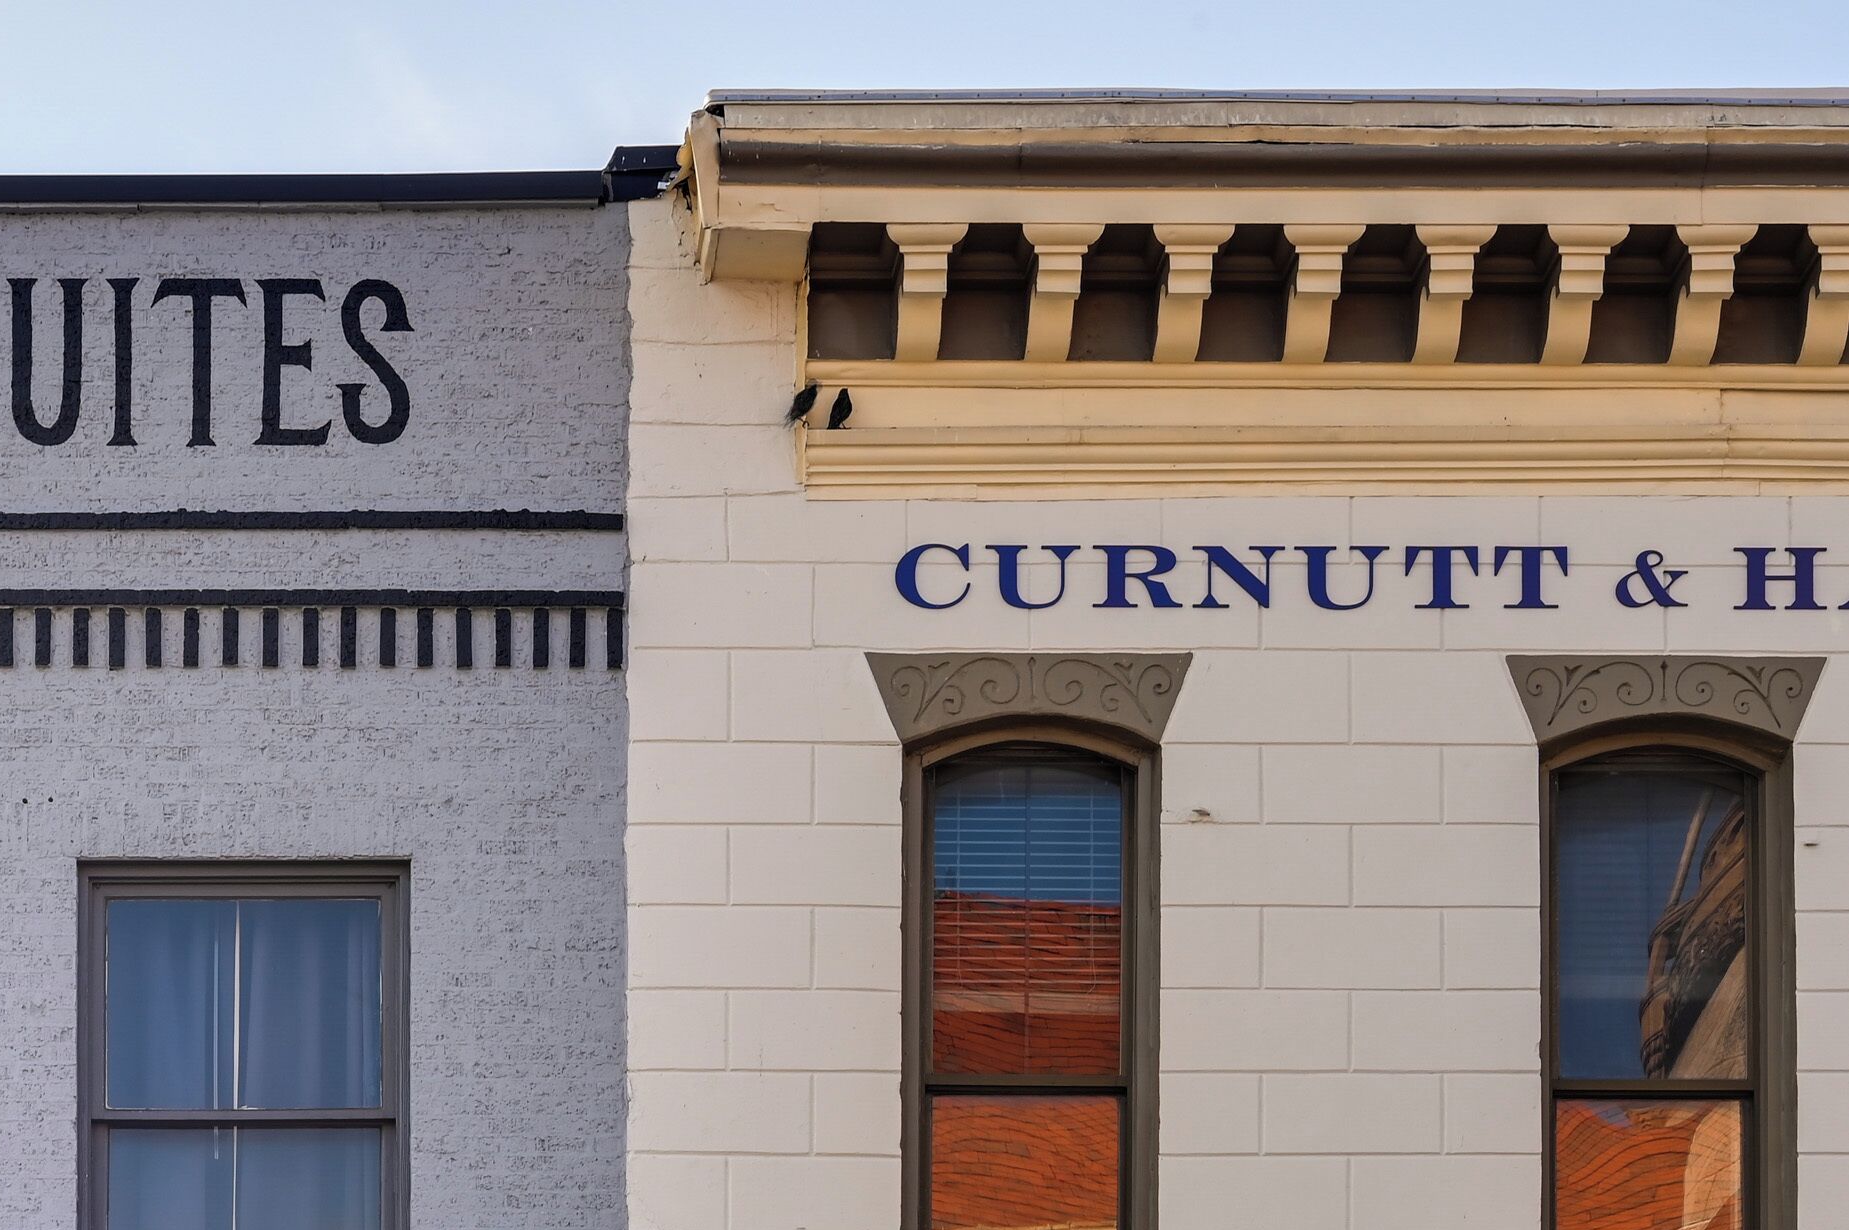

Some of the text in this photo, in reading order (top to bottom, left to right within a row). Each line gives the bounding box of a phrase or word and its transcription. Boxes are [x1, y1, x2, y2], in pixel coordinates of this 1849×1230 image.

[894, 544, 1849, 610] CURNUTT & H
